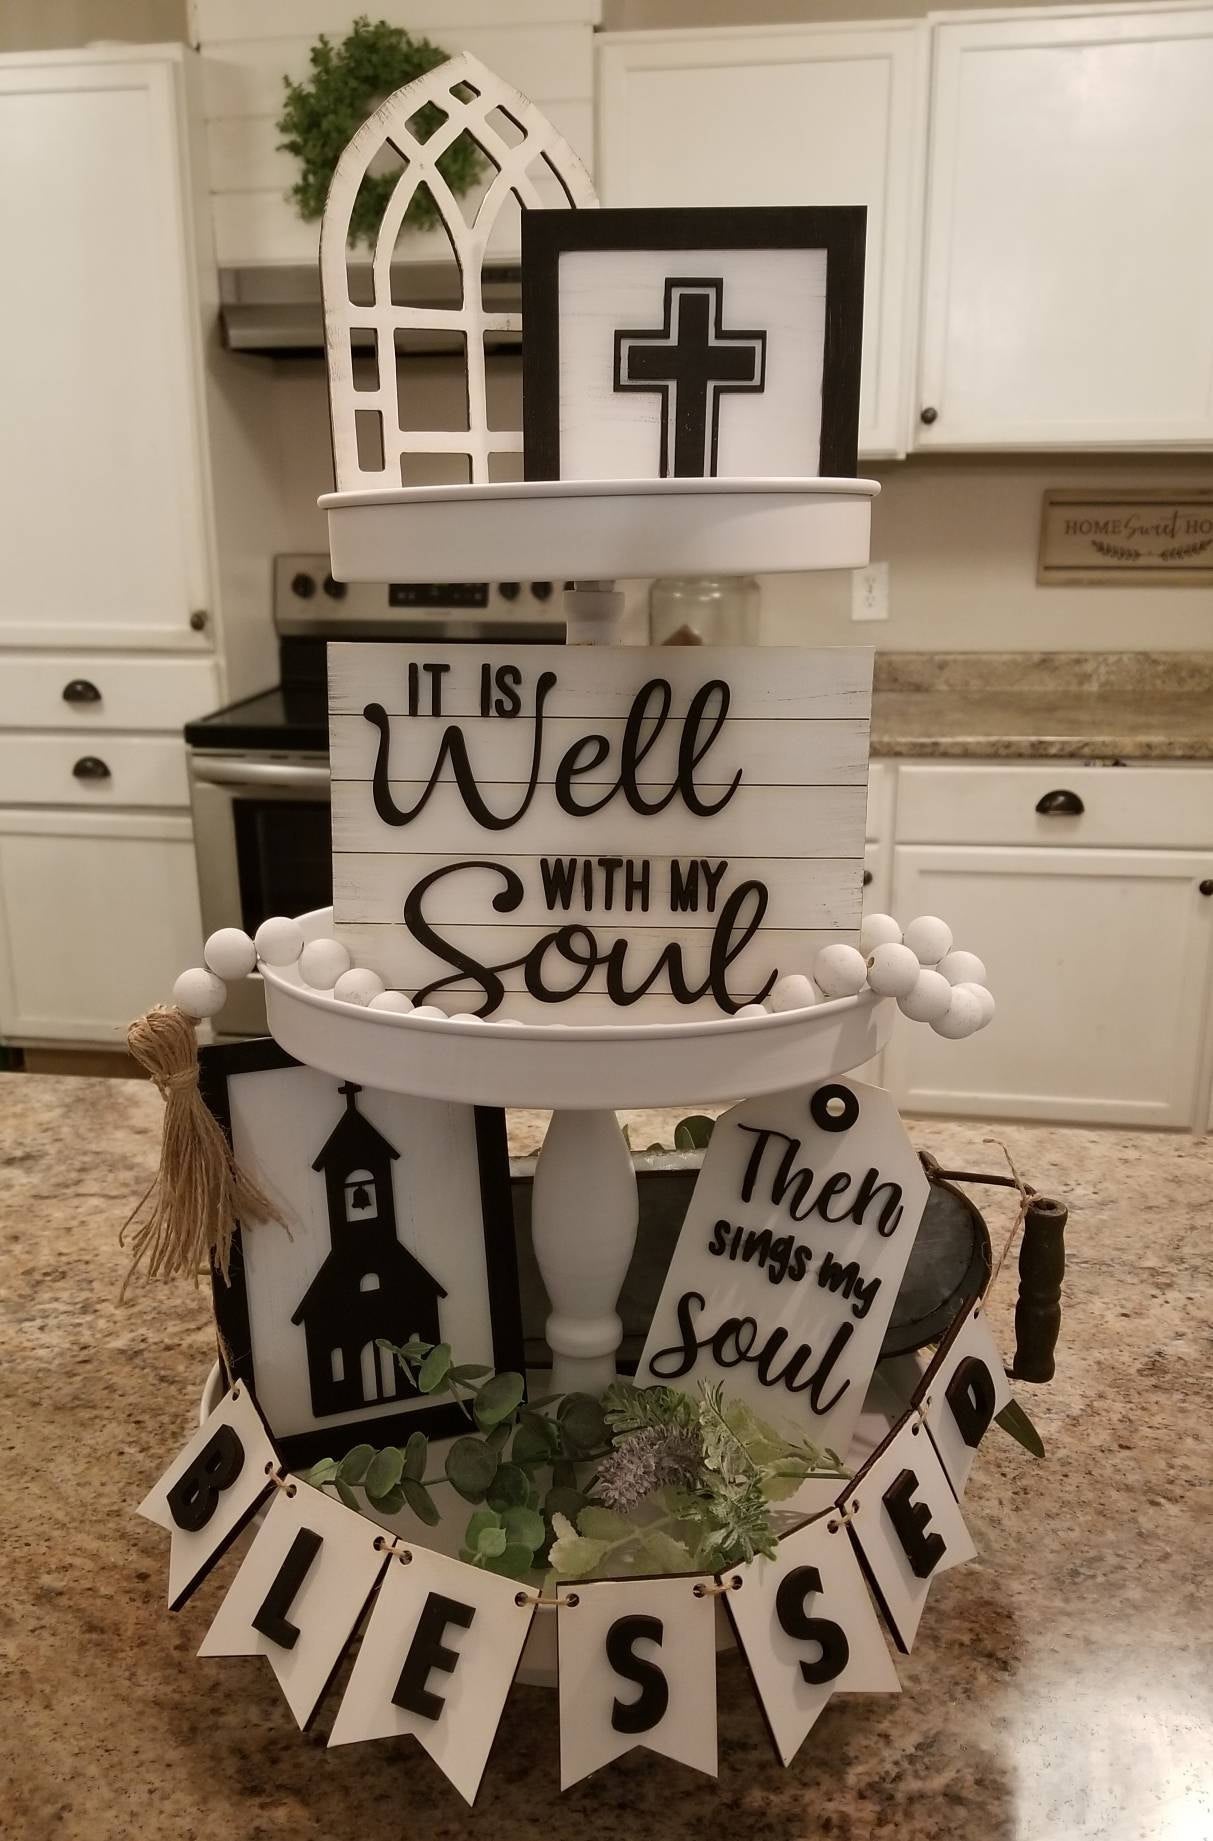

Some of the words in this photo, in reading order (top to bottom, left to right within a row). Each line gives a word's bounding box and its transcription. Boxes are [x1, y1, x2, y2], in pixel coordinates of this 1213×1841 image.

[1064, 519, 1122, 535] HOME
[1123, 510, 1180, 540] Sweet
[408, 662, 451, 717] IT
[480, 663, 522, 719] IS
[363, 671, 743, 831] Well
[403, 861, 778, 1020] Soul
[540, 857, 650, 912] WITH
[671, 859, 729, 913] MY
[738, 1123, 904, 1238] Then
[708, 1219, 813, 1285] sings
[817, 1251, 881, 1319] my
[649, 1291, 854, 1416] Soul
[166, 1355, 996, 1734] BLESSED
